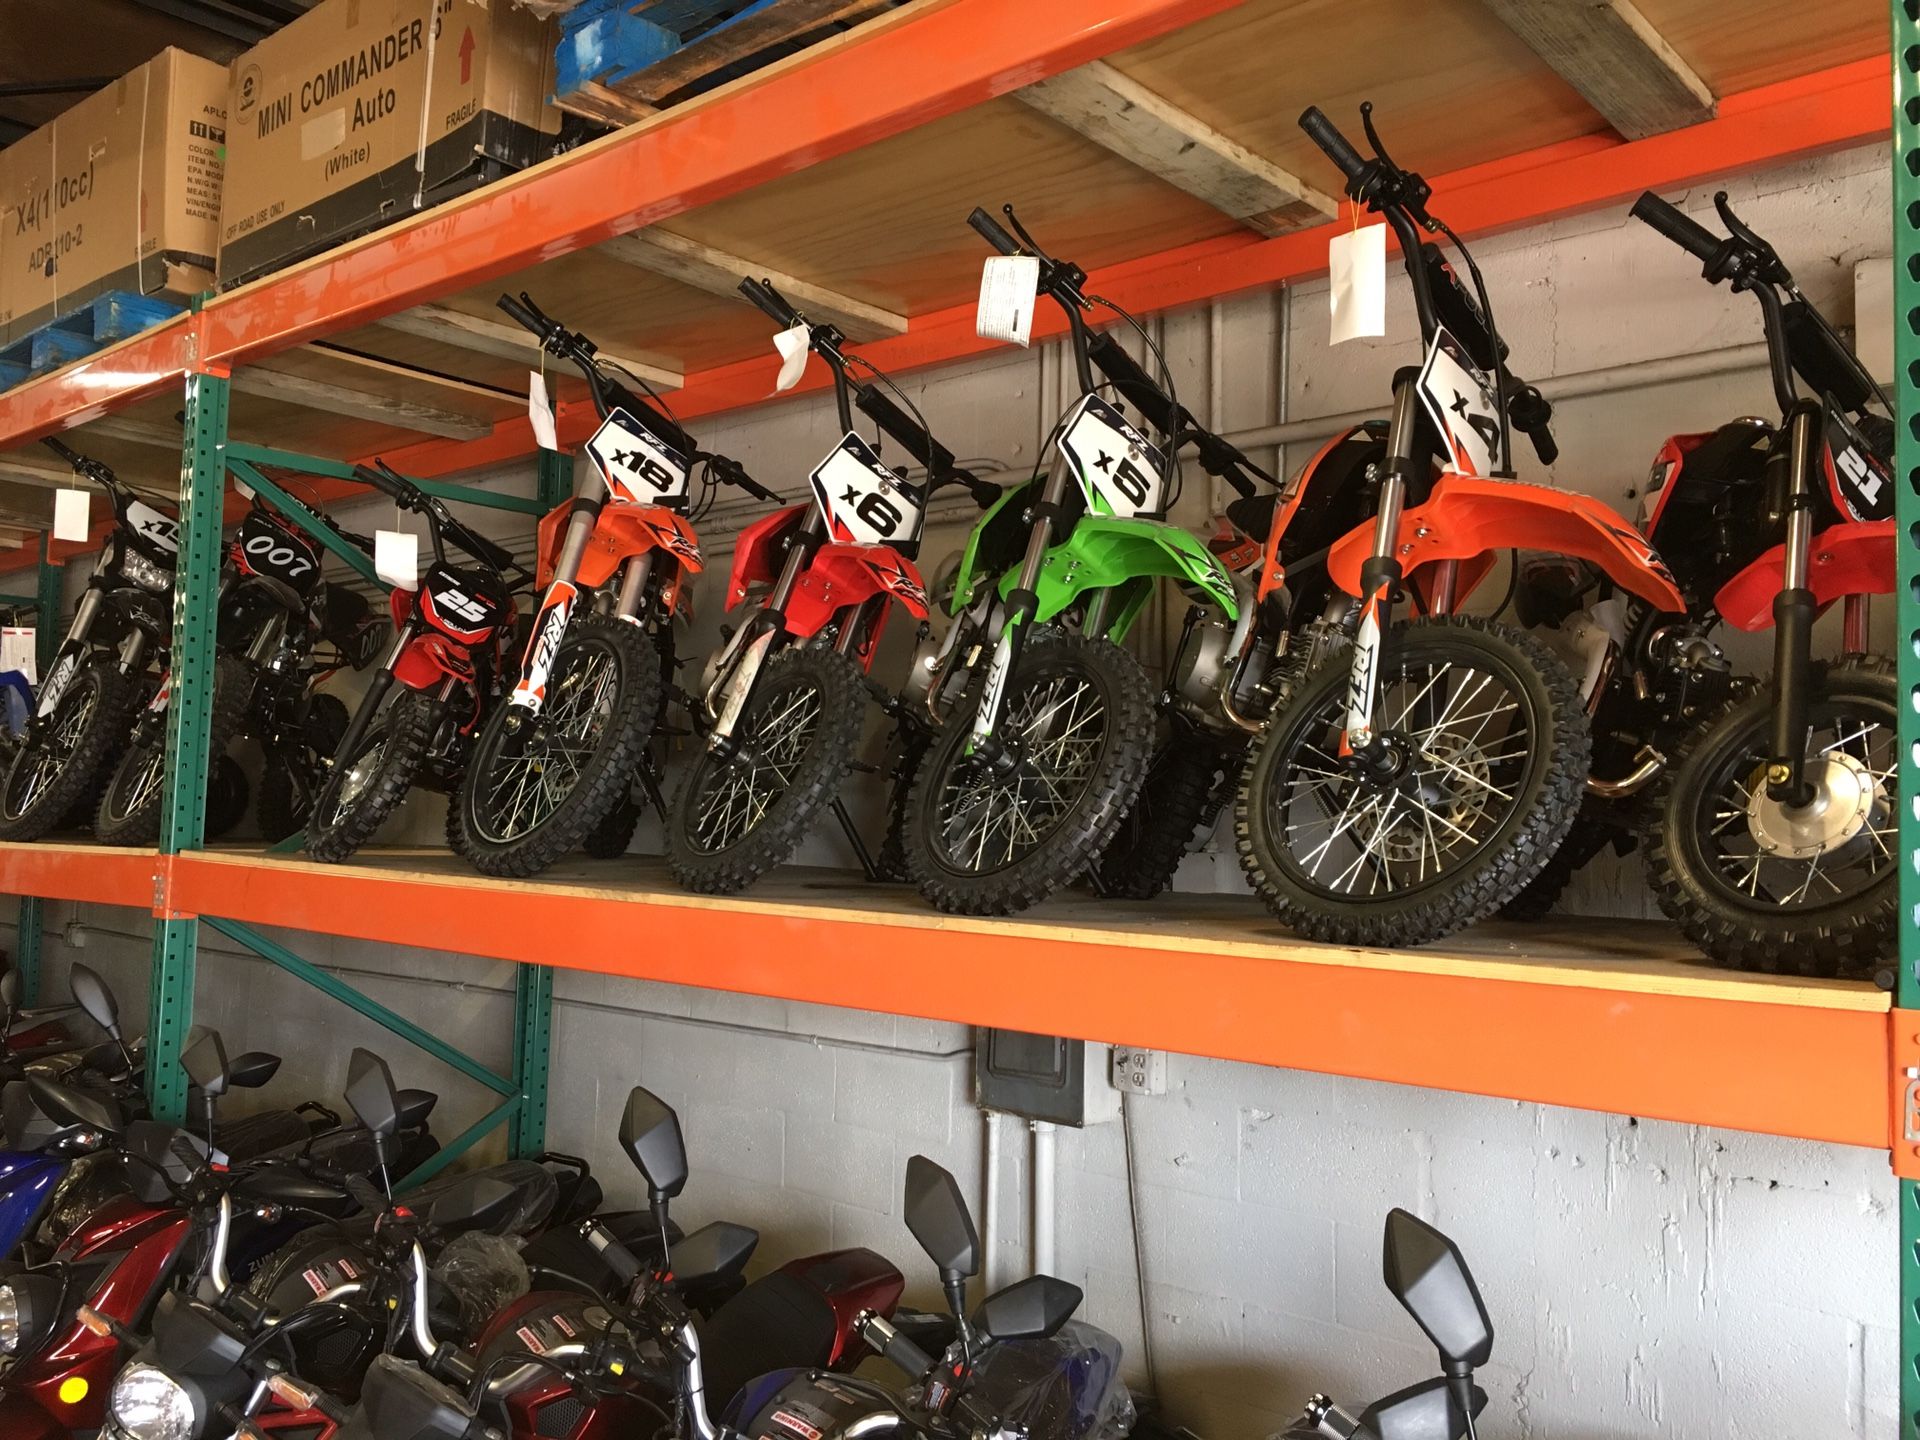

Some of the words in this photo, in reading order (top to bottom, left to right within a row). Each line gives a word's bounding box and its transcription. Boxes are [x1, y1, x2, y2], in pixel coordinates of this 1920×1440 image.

[258, 92, 293, 140] MINI
[300, 18, 423, 113] COMMANDER
[352, 86, 396, 132] Auto
[446, 98, 477, 131] FRAGILE
[187, 165, 202, 176] EPA
[188, 155, 206, 166] ITEM
[325, 141, 372, 182] (White)
[16, 161, 94, 236] X4(110cc)
[185, 207, 208, 220] MADE
[226, 223, 238, 240] OFF
[239, 215, 255, 233] ROAD
[256, 208, 268, 225] USE
[270, 199, 286, 218] ONLY
[608, 448, 675, 494] x18
[1092, 448, 1152, 509] x5
[1836, 445, 1884, 507] 21
[837, 482, 903, 538] x6
[245, 535, 312, 577] 007
[433, 588, 489, 623] 25
[774, 1412, 811, 1435] WARNING
